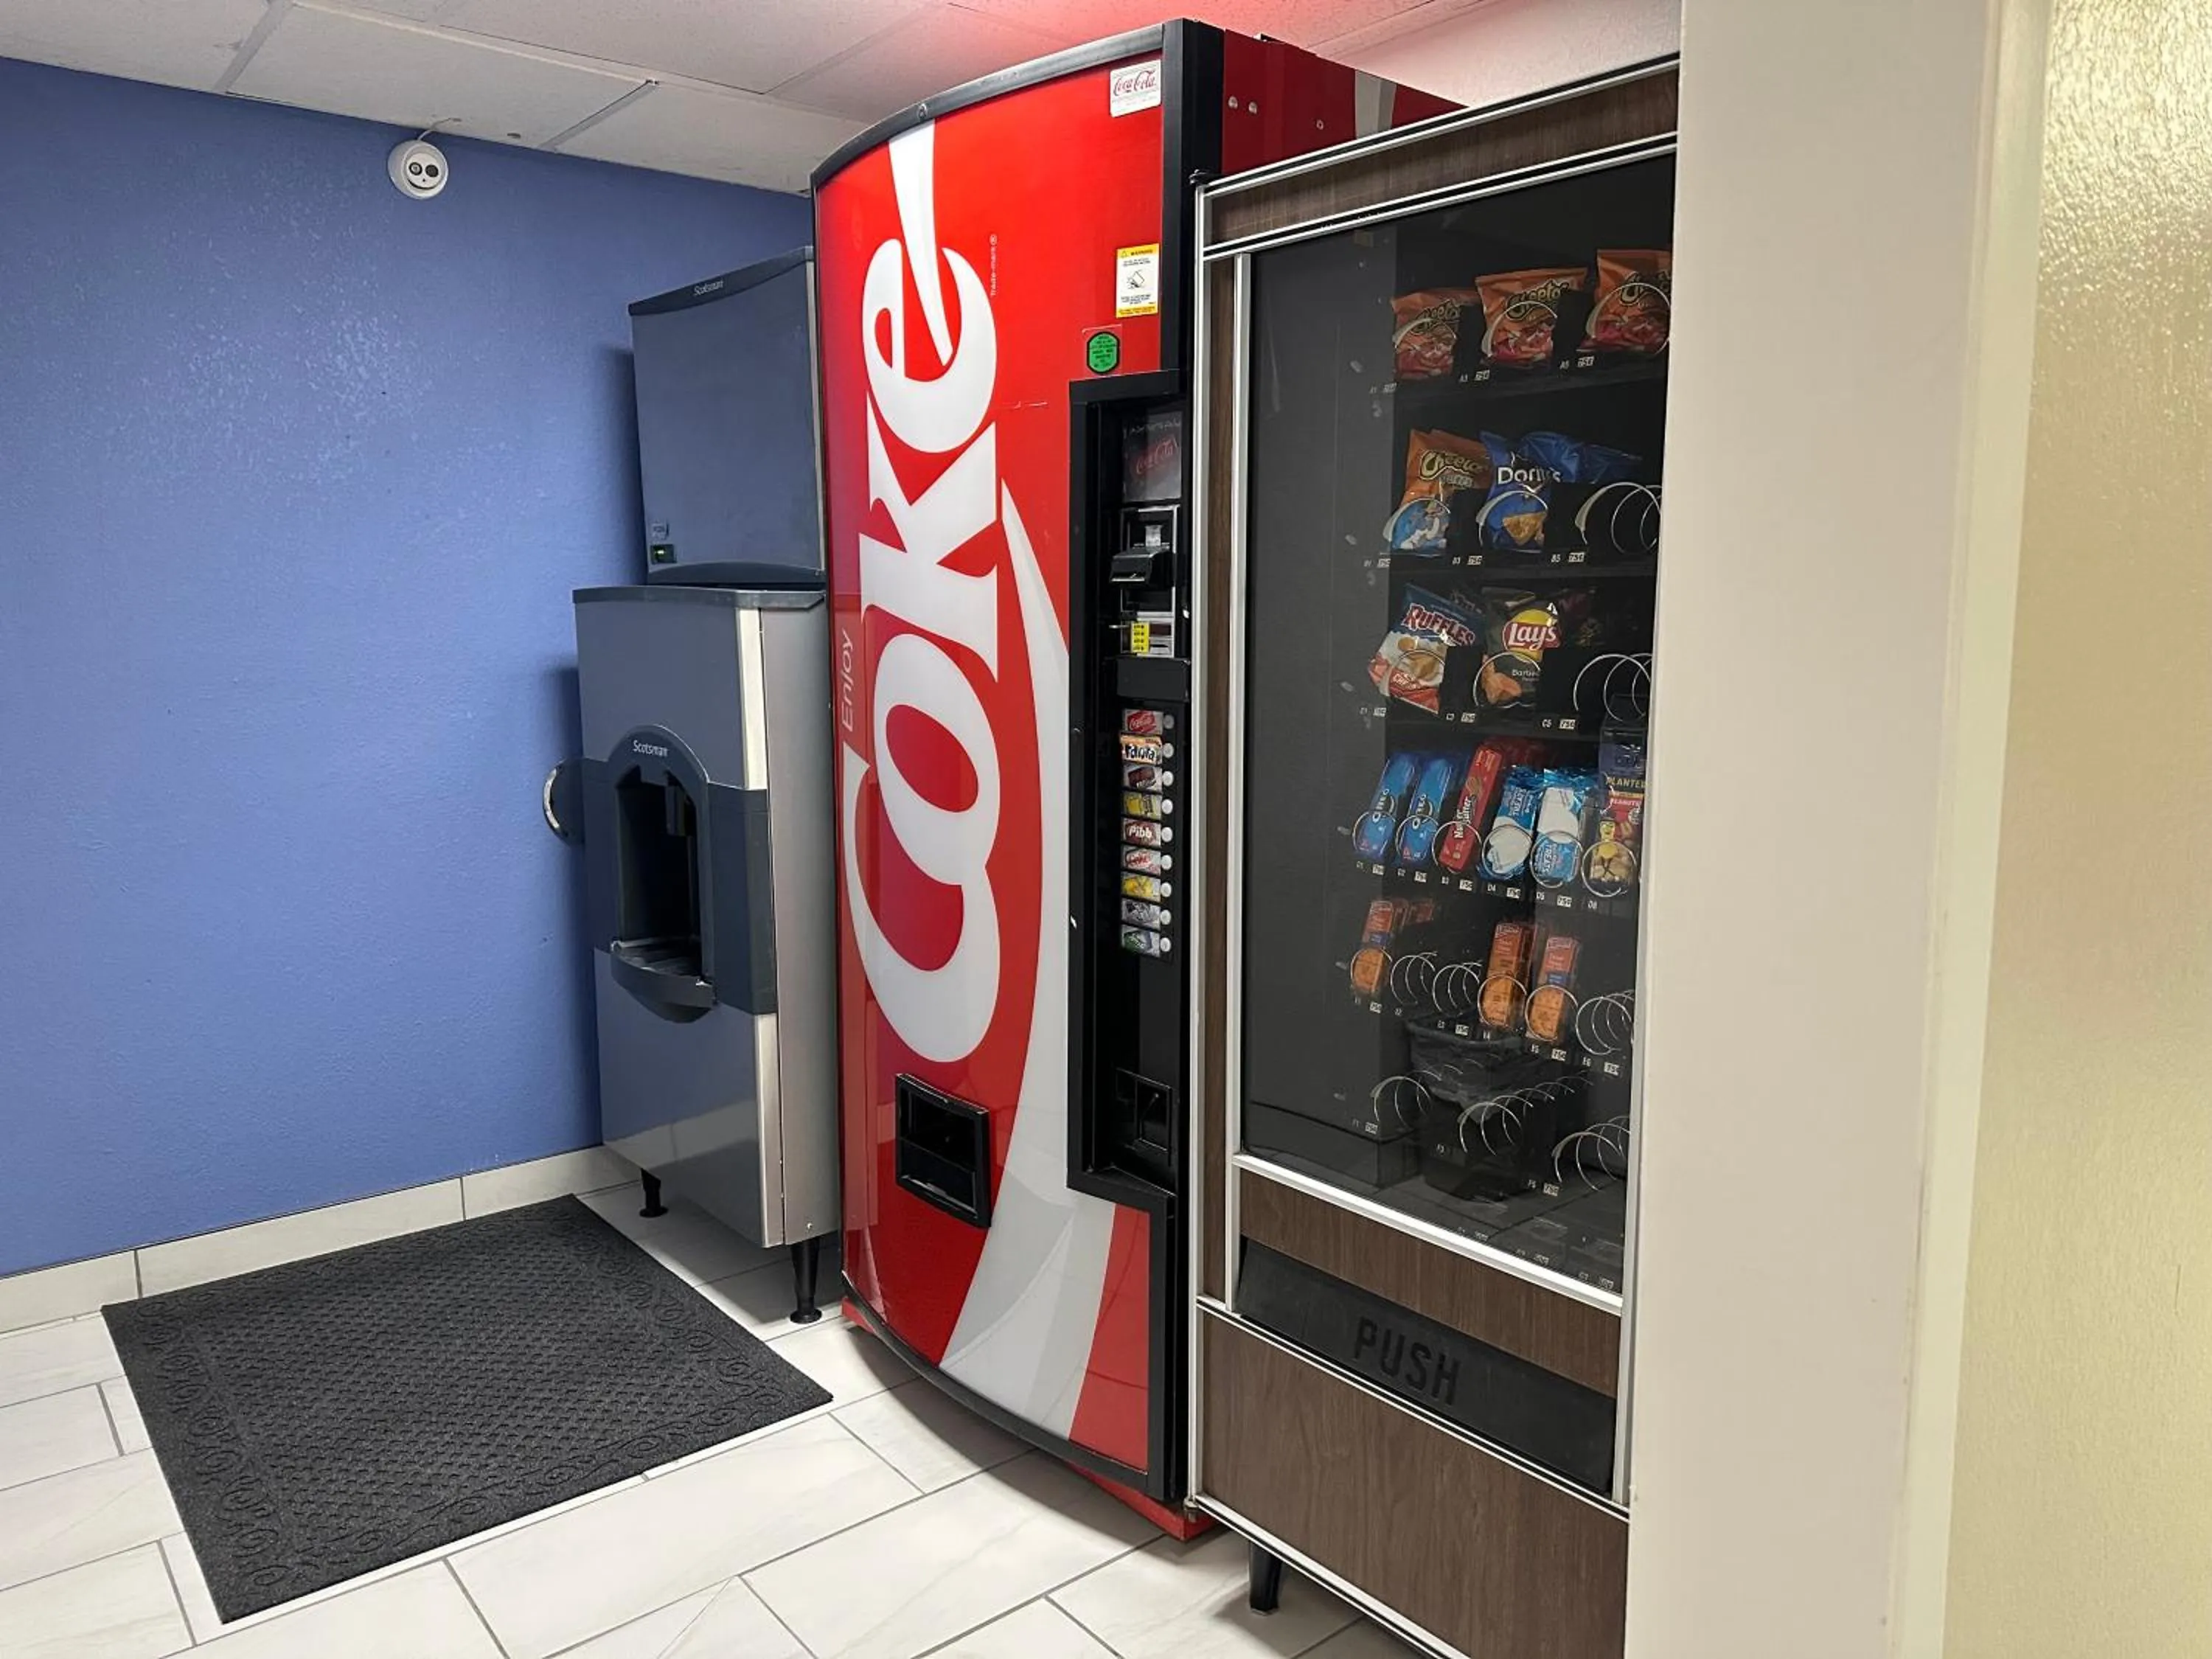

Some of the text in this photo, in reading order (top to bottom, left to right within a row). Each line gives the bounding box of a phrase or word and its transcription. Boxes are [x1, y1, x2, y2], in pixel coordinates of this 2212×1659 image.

[841, 237, 1001, 1063] Coke
[1401, 603, 1475, 647] RUFFLES
[841, 627, 854, 732] Enjoy
[633, 740, 668, 757] Scotsman
[1129, 825, 1152, 838] Pibb
[1354, 1316, 1461, 1405] PUSH
